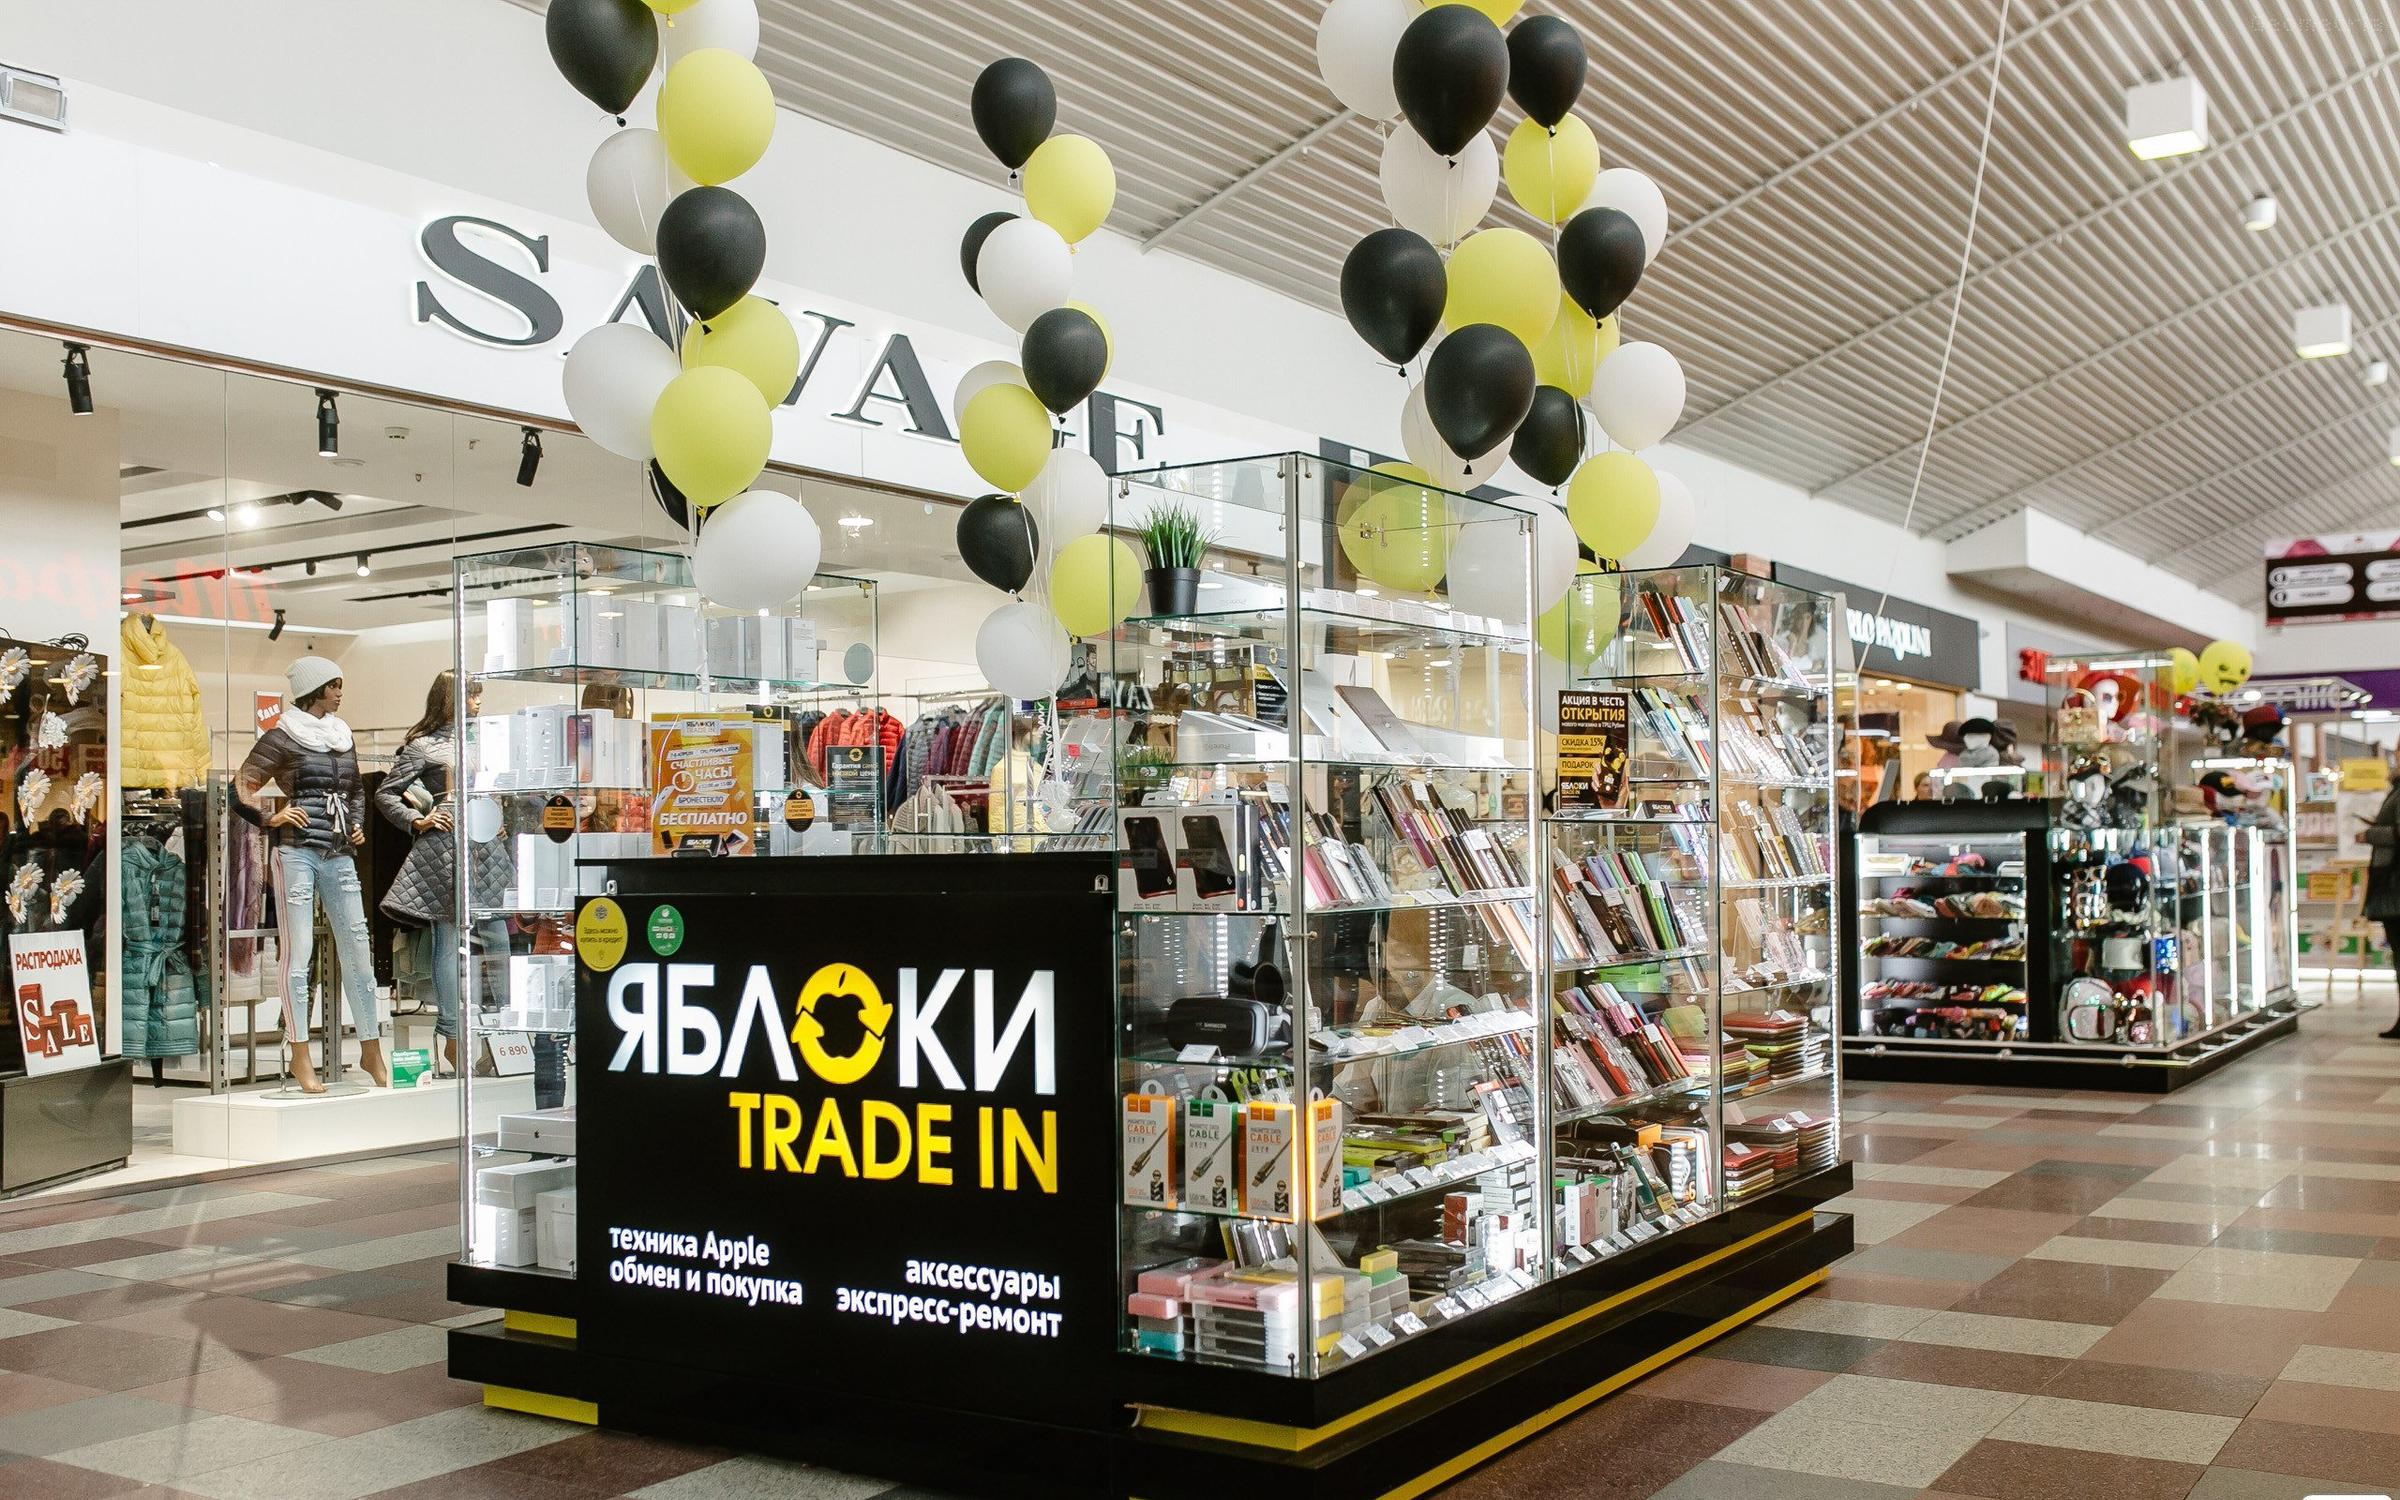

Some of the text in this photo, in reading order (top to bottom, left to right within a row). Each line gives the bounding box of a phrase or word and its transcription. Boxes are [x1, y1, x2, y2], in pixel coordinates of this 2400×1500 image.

[416, 214, 1167, 487] SAAE
[1562, 695, 1625, 707] АКЦИЯ В ЧЕСТЬ
[257, 703, 280, 721] SALE
[1561, 707, 1625, 721] ОТКРЫТИЯ
[1562, 737, 1603, 746] СКИДКА 15%
[670, 756, 733, 770] СЧАСТЛИВЫЕ
[1561, 760, 1594, 769] ПОДАРОК
[695, 766, 735, 780] ЧАСЫ
[660, 812, 747, 825] БЕСПЛАТНО
[16, 948, 83, 971] РАСПРОДАЖА
[23, 999, 91, 1054] SALE
[607, 963, 1056, 1095] ЯБЛОКИ
[509, 1045, 528, 1056] 890
[1127, 1124, 1157, 1135] CABLE
[1189, 1128, 1220, 1140] CABLE
[729, 1091, 1058, 1193] TRADE IN
[1250, 1133, 1281, 1144] CABLE
[608, 1227, 770, 1270] техника Apple
[609, 1255, 803, 1307] обмен и покупка
[905, 1259, 1061, 1304] аксессуары
[835, 1287, 1063, 1338] экспресс-ремонт
